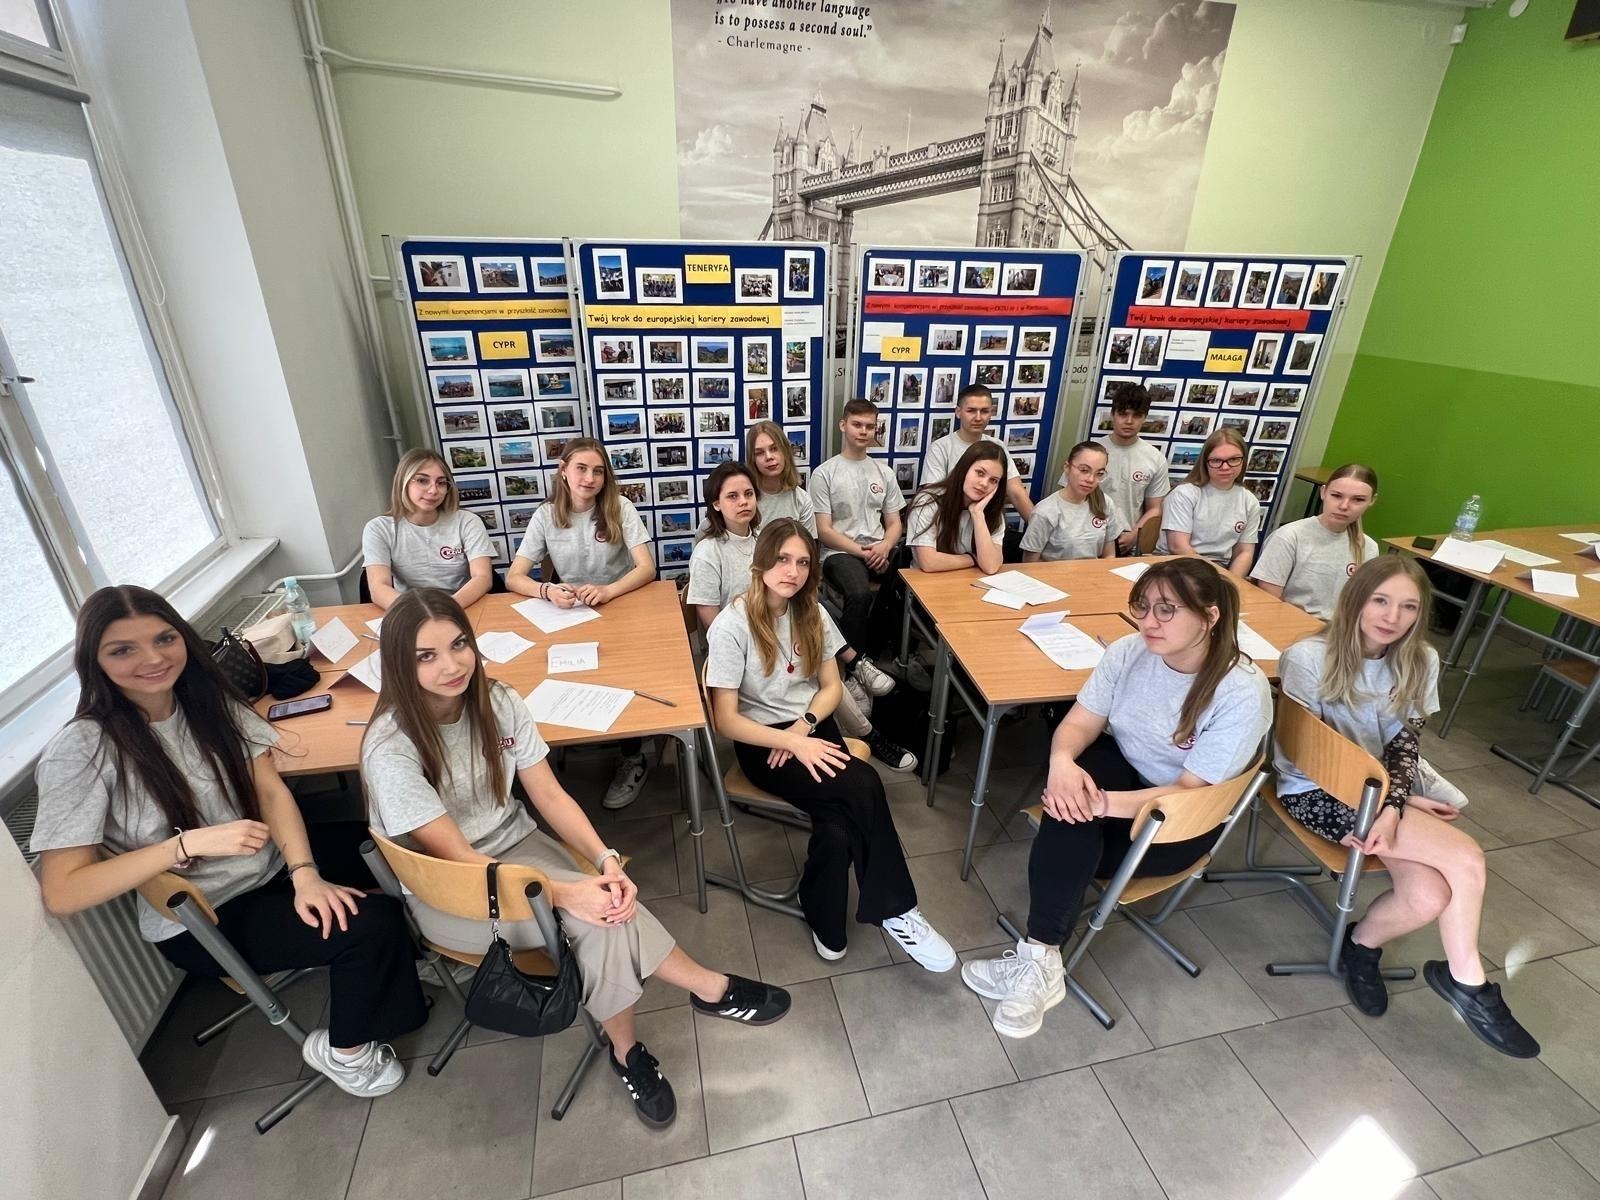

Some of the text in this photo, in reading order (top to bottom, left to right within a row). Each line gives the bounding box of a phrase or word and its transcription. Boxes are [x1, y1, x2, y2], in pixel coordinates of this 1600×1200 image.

[771, 0, 817, 12] another
[820, 0, 871, 20] language
[714, 11, 725, 25] is
[729, 13, 740, 26] to
[744, 17, 786, 32] possess
[789, 21, 796, 31] a
[799, 22, 838, 36] second
[726, 35, 804, 54] Charlemagne
[686, 263, 730, 273] TENERYFA
[424, 308, 449, 317] nowymi
[451, 307, 499, 317] kompetencjami
[507, 306, 536, 316] przyszłość
[587, 313, 770, 325] Twój krok do europejskiej kariery zawodowej
[1130, 313, 1292, 327] Twój krok do europejskiej kariery zawodowej
[492, 341, 516, 349] CYPR
[891, 345, 911, 355] CYPR
[1210, 353, 1243, 362] MALAGA
